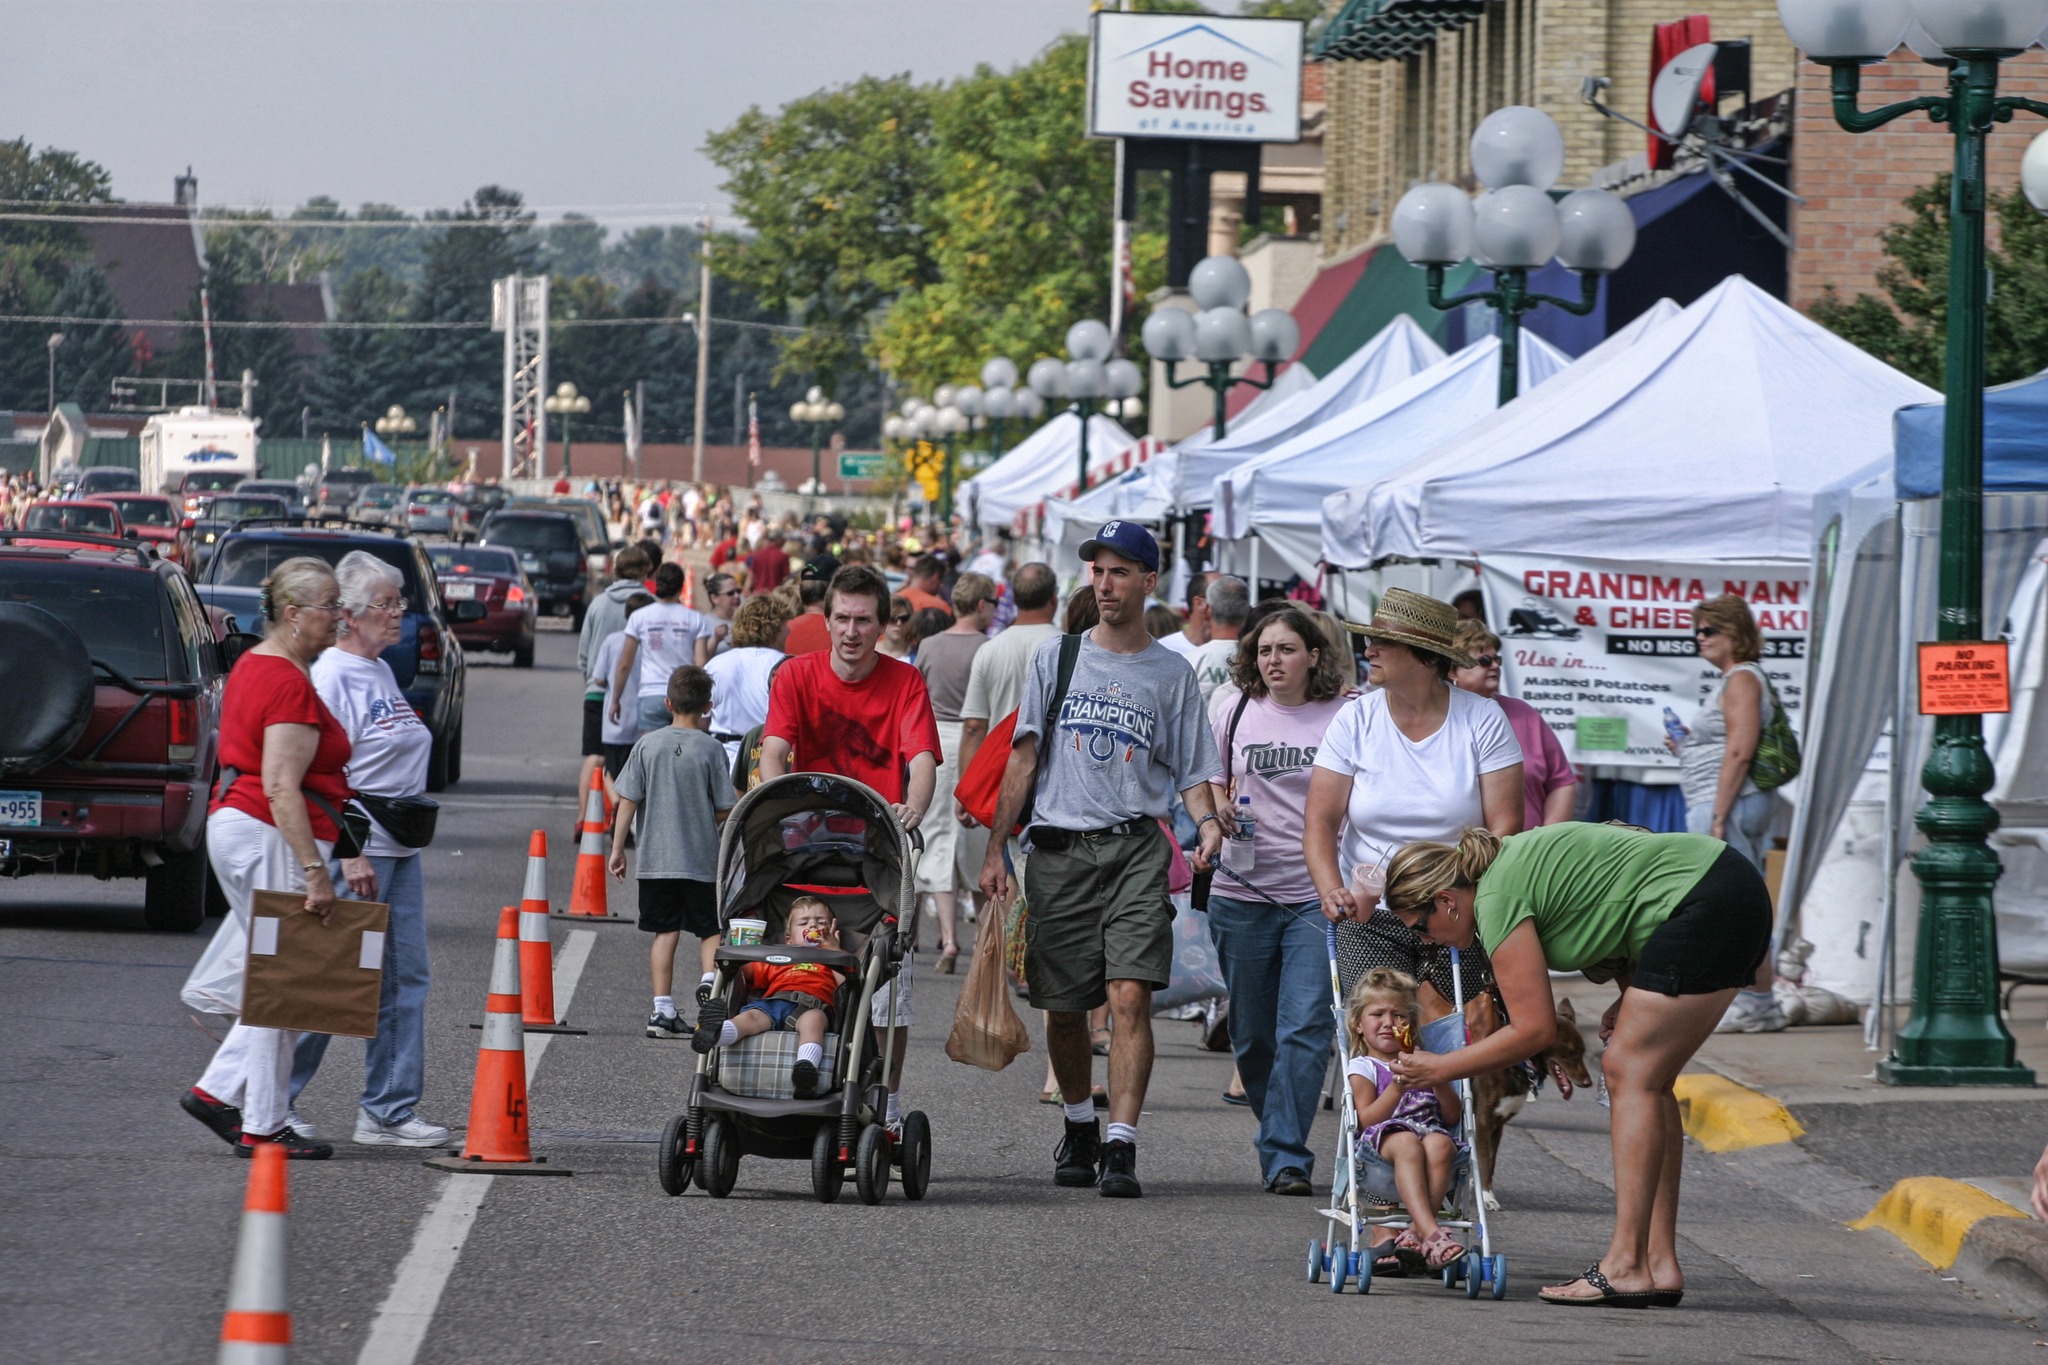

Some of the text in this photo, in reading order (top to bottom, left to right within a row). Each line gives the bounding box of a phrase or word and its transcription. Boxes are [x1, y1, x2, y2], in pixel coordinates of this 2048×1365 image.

[1149, 51, 1248, 81] Home
[1128, 81, 1266, 119] Savings
[1170, 119, 1255, 133] America
[1524, 570, 1706, 603] GRANDMA
[1574, 605, 1598, 627] &
[1628, 640, 1654, 653] NO
[1657, 640, 1697, 654] MSG
[1955, 650, 1975, 660] NO
[1515, 650, 1558, 668] Use
[1935, 660, 1995, 671] PARKING
[1524, 677, 1671, 692] Mashed Potatoes
[1066, 691, 1156, 720] AFC CONFERENCE
[1523, 691, 1655, 705] Baked Potatoes
[1060, 700, 1155, 741] CHAMPIONS
[1241, 740, 1319, 777] Twins
[9, 801, 36, 819] 955
